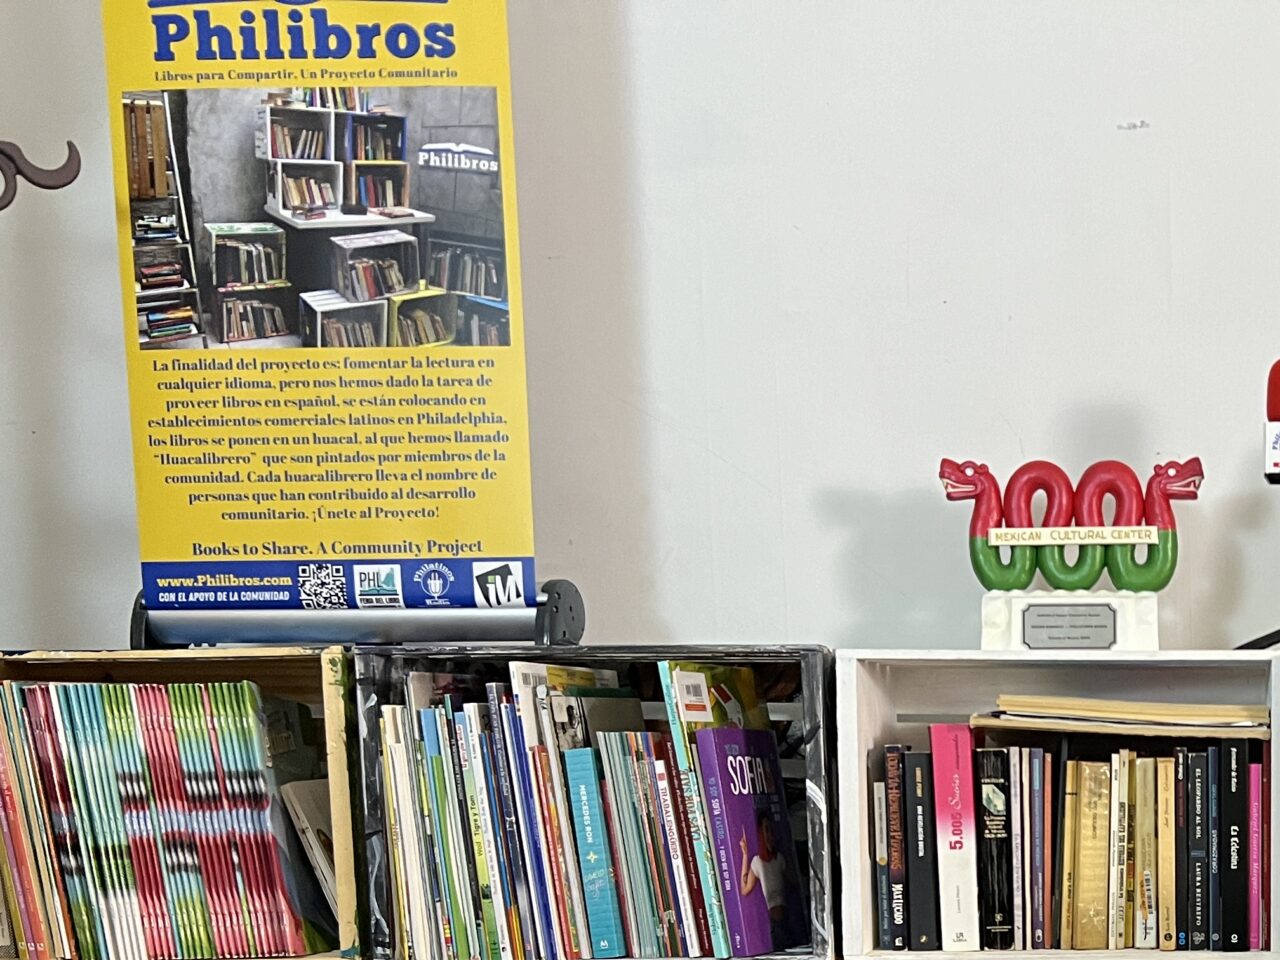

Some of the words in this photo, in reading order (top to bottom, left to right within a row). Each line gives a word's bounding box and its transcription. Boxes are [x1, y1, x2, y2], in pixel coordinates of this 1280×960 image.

[151, 8, 456, 62] Philibros
[154, 70, 194, 83] Libros
[195, 70, 226, 84] para
[300, 68, 318, 80] Un
[320, 68, 376, 82] Proyecto
[378, 66, 458, 79] Comunitario
[418, 151, 499, 172] Philibros
[152, 359, 169, 372] La
[171, 357, 234, 372] finalidad
[235, 357, 259, 371] del
[260, 358, 321, 374] proyecto
[322, 360, 341, 370] es:
[343, 356, 409, 370] fomentar
[410, 355, 423, 369] la
[425, 355, 475, 369] lectura
[477, 359, 495, 368] en
[221, 507, 311, 521] comunitario.
[359, 506, 372, 519] al
[374, 506, 439, 522] Proyecto!
[995, 531, 1042, 542] MEXICAN
[1050, 530, 1107, 541] CULTURAL
[1111, 529, 1152, 540] CENTER
[192, 541, 240, 556] Books
[242, 543, 259, 556] to
[261, 540, 313, 555] Share.
[316, 541, 330, 555] A
[331, 539, 422, 558] Community
[427, 539, 482, 557] Project
[157, 574, 293, 587] www.Philibros.com
[359, 571, 382, 588] PHL
[413, 562, 456, 583] Philatinos
[158, 592, 176, 602] CON
[178, 592, 187, 602] EL
[188, 591, 216, 602] APOYO
[217, 591, 227, 601] DE
[228, 591, 239, 601] LA
[241, 591, 290, 601] COMUNIDAD
[1195, 767, 1202, 778] EL
[578, 784, 592, 827] MERCEDES
[585, 826, 593, 844] RON
[1195, 816, 1202, 825] AL
[949, 812, 963, 850] 5.005
